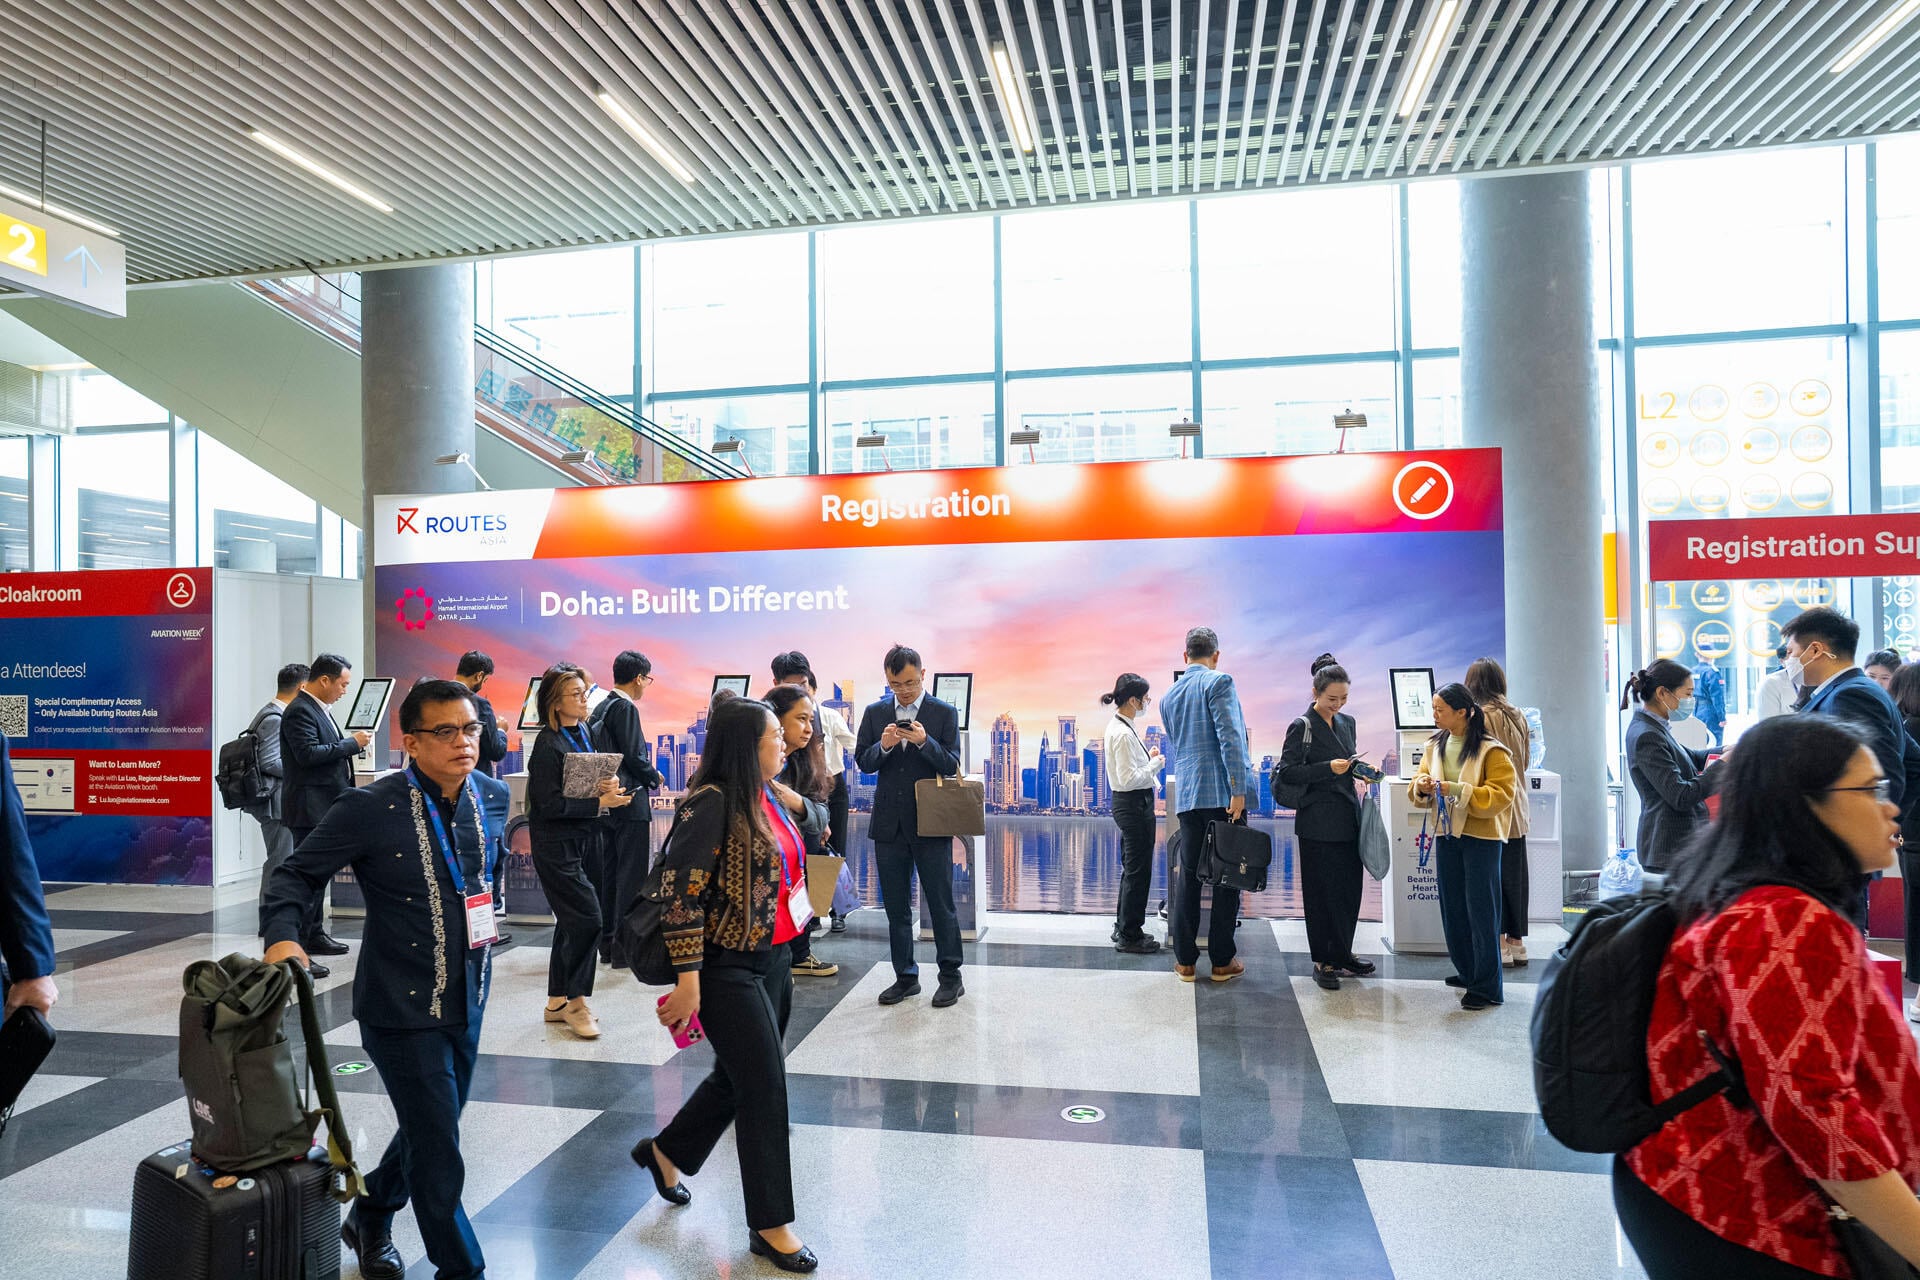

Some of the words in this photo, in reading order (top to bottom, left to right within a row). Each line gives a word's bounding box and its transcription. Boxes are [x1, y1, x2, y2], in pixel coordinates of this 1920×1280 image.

[8, 224, 37, 268] 2
[1640, 391, 1678, 420] L2
[821, 488, 1010, 527] Registration
[426, 514, 507, 534] ROUTES
[480, 536, 507, 546] ASIA
[1687, 532, 1865, 565] Registration
[0, 585, 82, 603] Cloakroom
[540, 590, 624, 617] Doha:
[631, 587, 701, 615] Built
[708, 584, 850, 613] Different
[489, 603, 508, 611] Airport
[150, 630, 181, 638] AVIATION
[182, 628, 203, 638] WEEK
[12, 661, 87, 679] Attendees!
[34, 697, 60, 707] Special
[61, 697, 115, 707] Complimentary
[115, 697, 142, 706] Access
[41, 708, 57, 719] Only
[58, 708, 90, 717] Available
[91, 708, 114, 719] During
[115, 708, 141, 717] Routes
[142, 708, 158, 717] Asia
[88, 760, 107, 769] Want
[108, 761, 116, 769] to
[117, 760, 137, 769] Learn
[138, 761, 161, 769] More?
[138, 775, 162, 783] Regional
[1412, 884, 1438, 892] Heart
[1407, 892, 1417, 900] of
[1418, 893, 1440, 901] Qata
